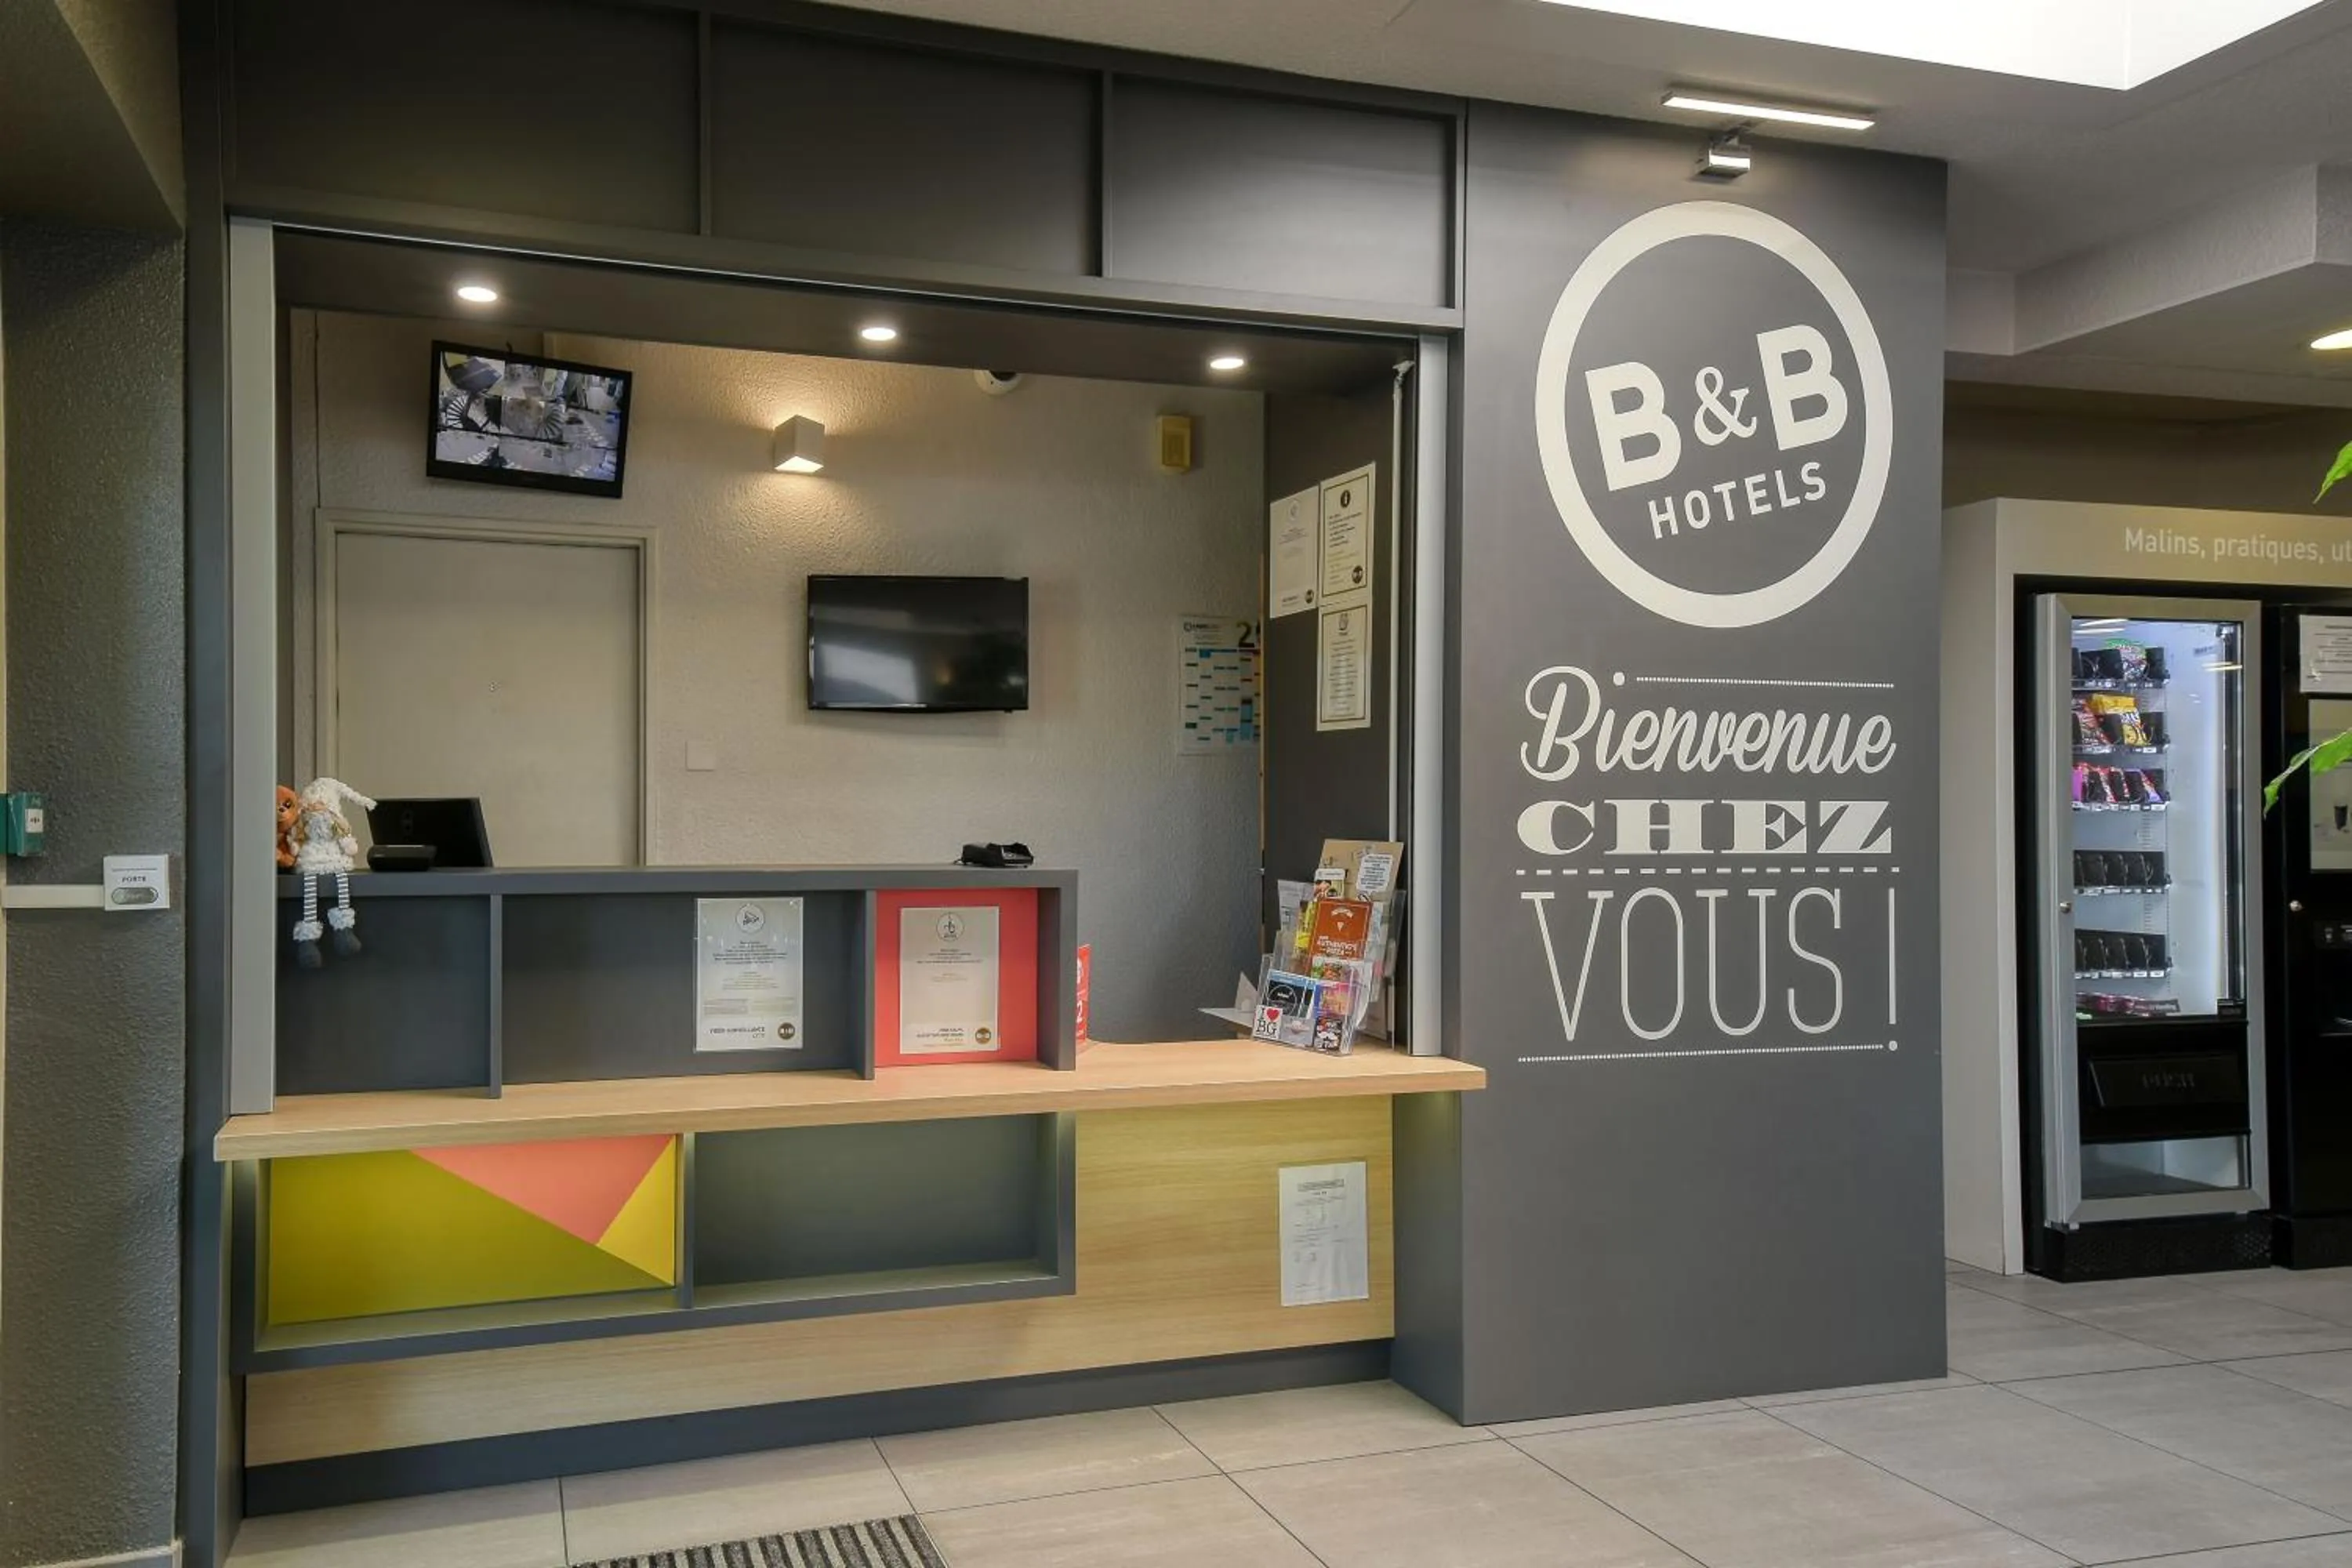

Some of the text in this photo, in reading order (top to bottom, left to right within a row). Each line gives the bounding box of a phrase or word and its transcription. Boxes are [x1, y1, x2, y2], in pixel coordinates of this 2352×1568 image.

[1584, 324, 1848, 492] B&B
[1648, 461, 1827, 539] HOTELS
[2125, 527, 2205, 559] Malins,
[2213, 534, 2325, 564] pratiques,
[1519, 665, 1897, 782] Bienvenue
[1517, 799, 1893, 855] CHEZ
[1256, 1019, 1277, 1035] BG
